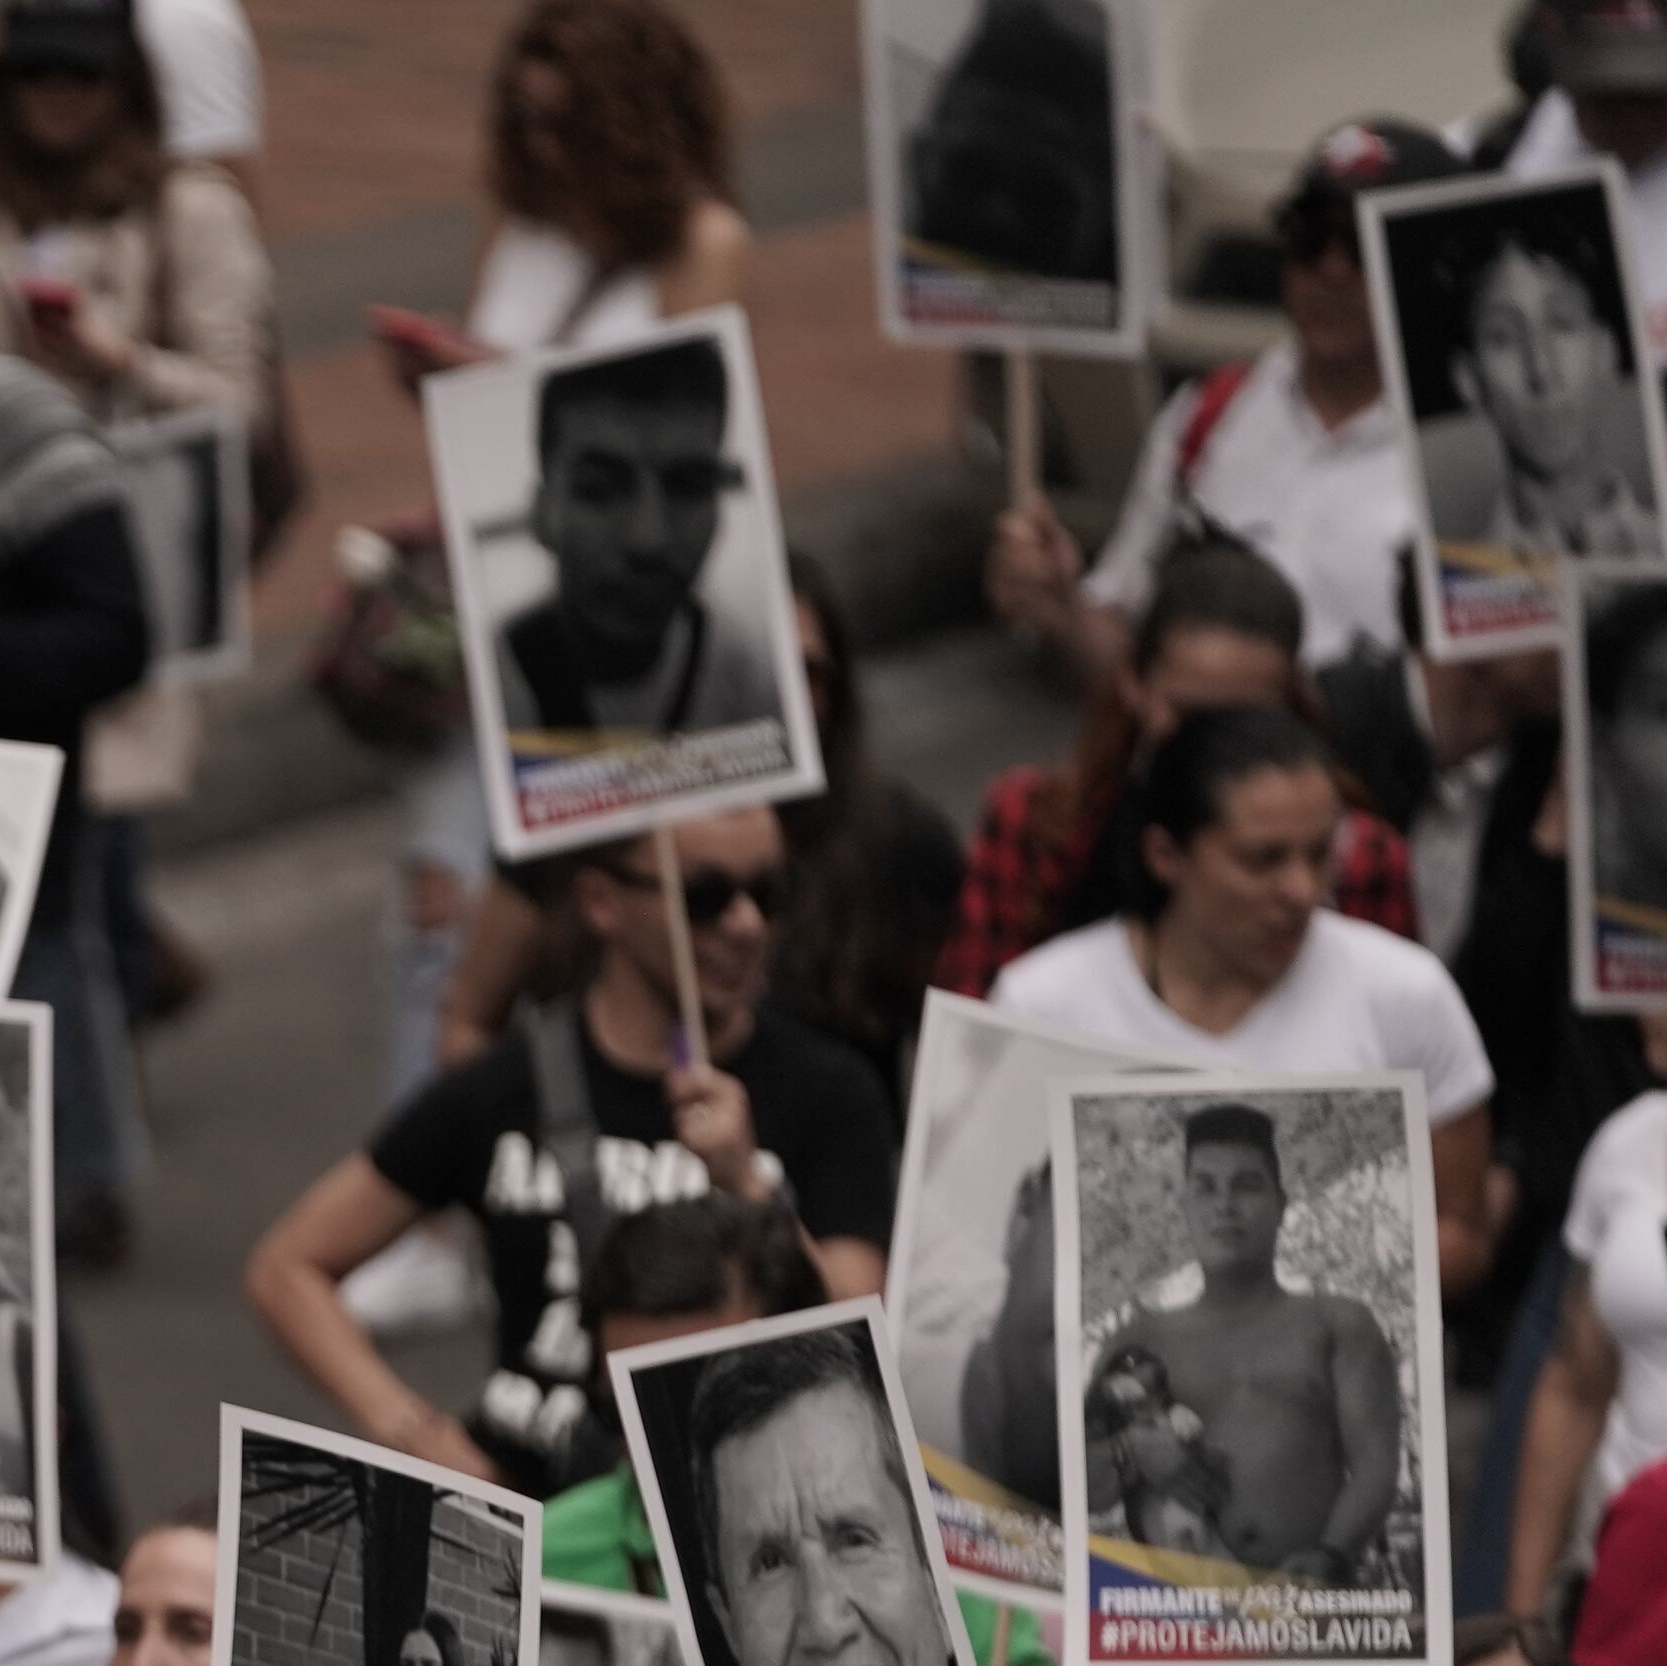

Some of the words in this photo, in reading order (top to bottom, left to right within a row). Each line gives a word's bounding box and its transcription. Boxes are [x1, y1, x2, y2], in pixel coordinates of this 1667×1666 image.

[1100, 1586, 1223, 1616] FIRMANTE
[1298, 1590, 1413, 1615] ASESINADO
[1100, 1617, 1413, 1653] #PROTEJAMOSLAVIDA
